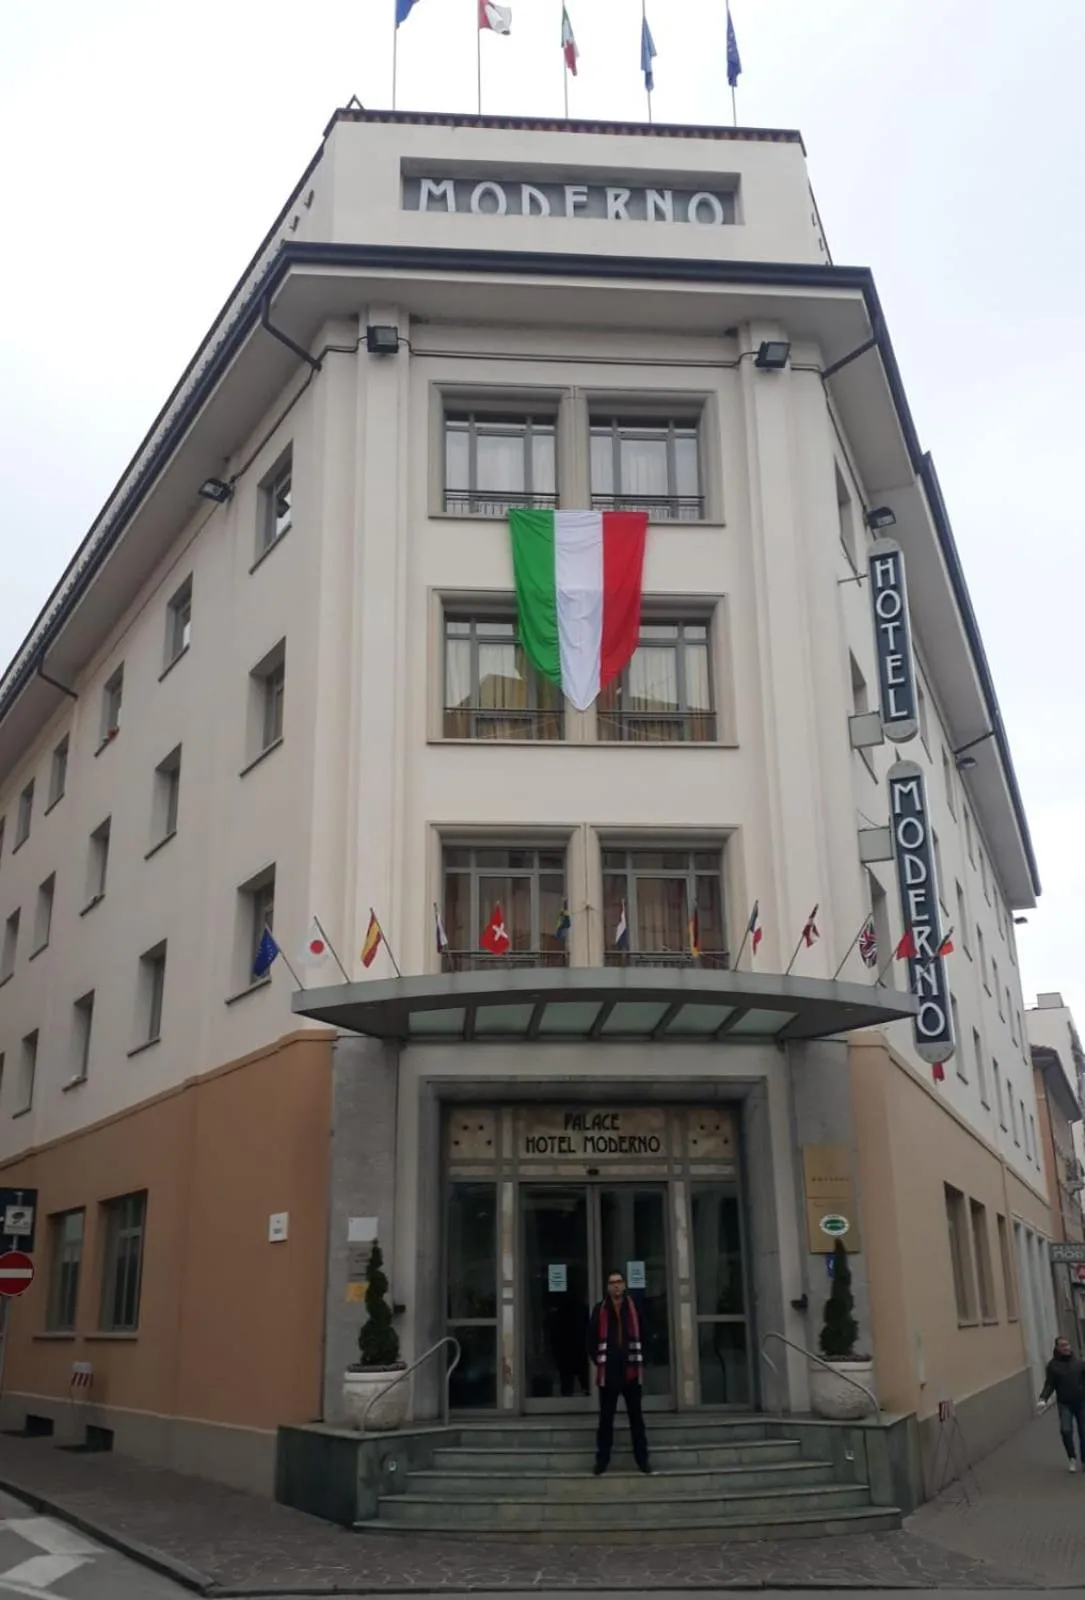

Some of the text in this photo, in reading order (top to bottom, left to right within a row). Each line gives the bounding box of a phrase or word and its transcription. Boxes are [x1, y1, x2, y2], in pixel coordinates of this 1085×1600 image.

[419, 178, 725, 225] MODERNO
[874, 557, 908, 717] HOTEL
[892, 780, 945, 1036] MODERNO
[526, 1136, 661, 1154] HOTEL MODERNO
[564, 1113, 620, 1130] PALACE
